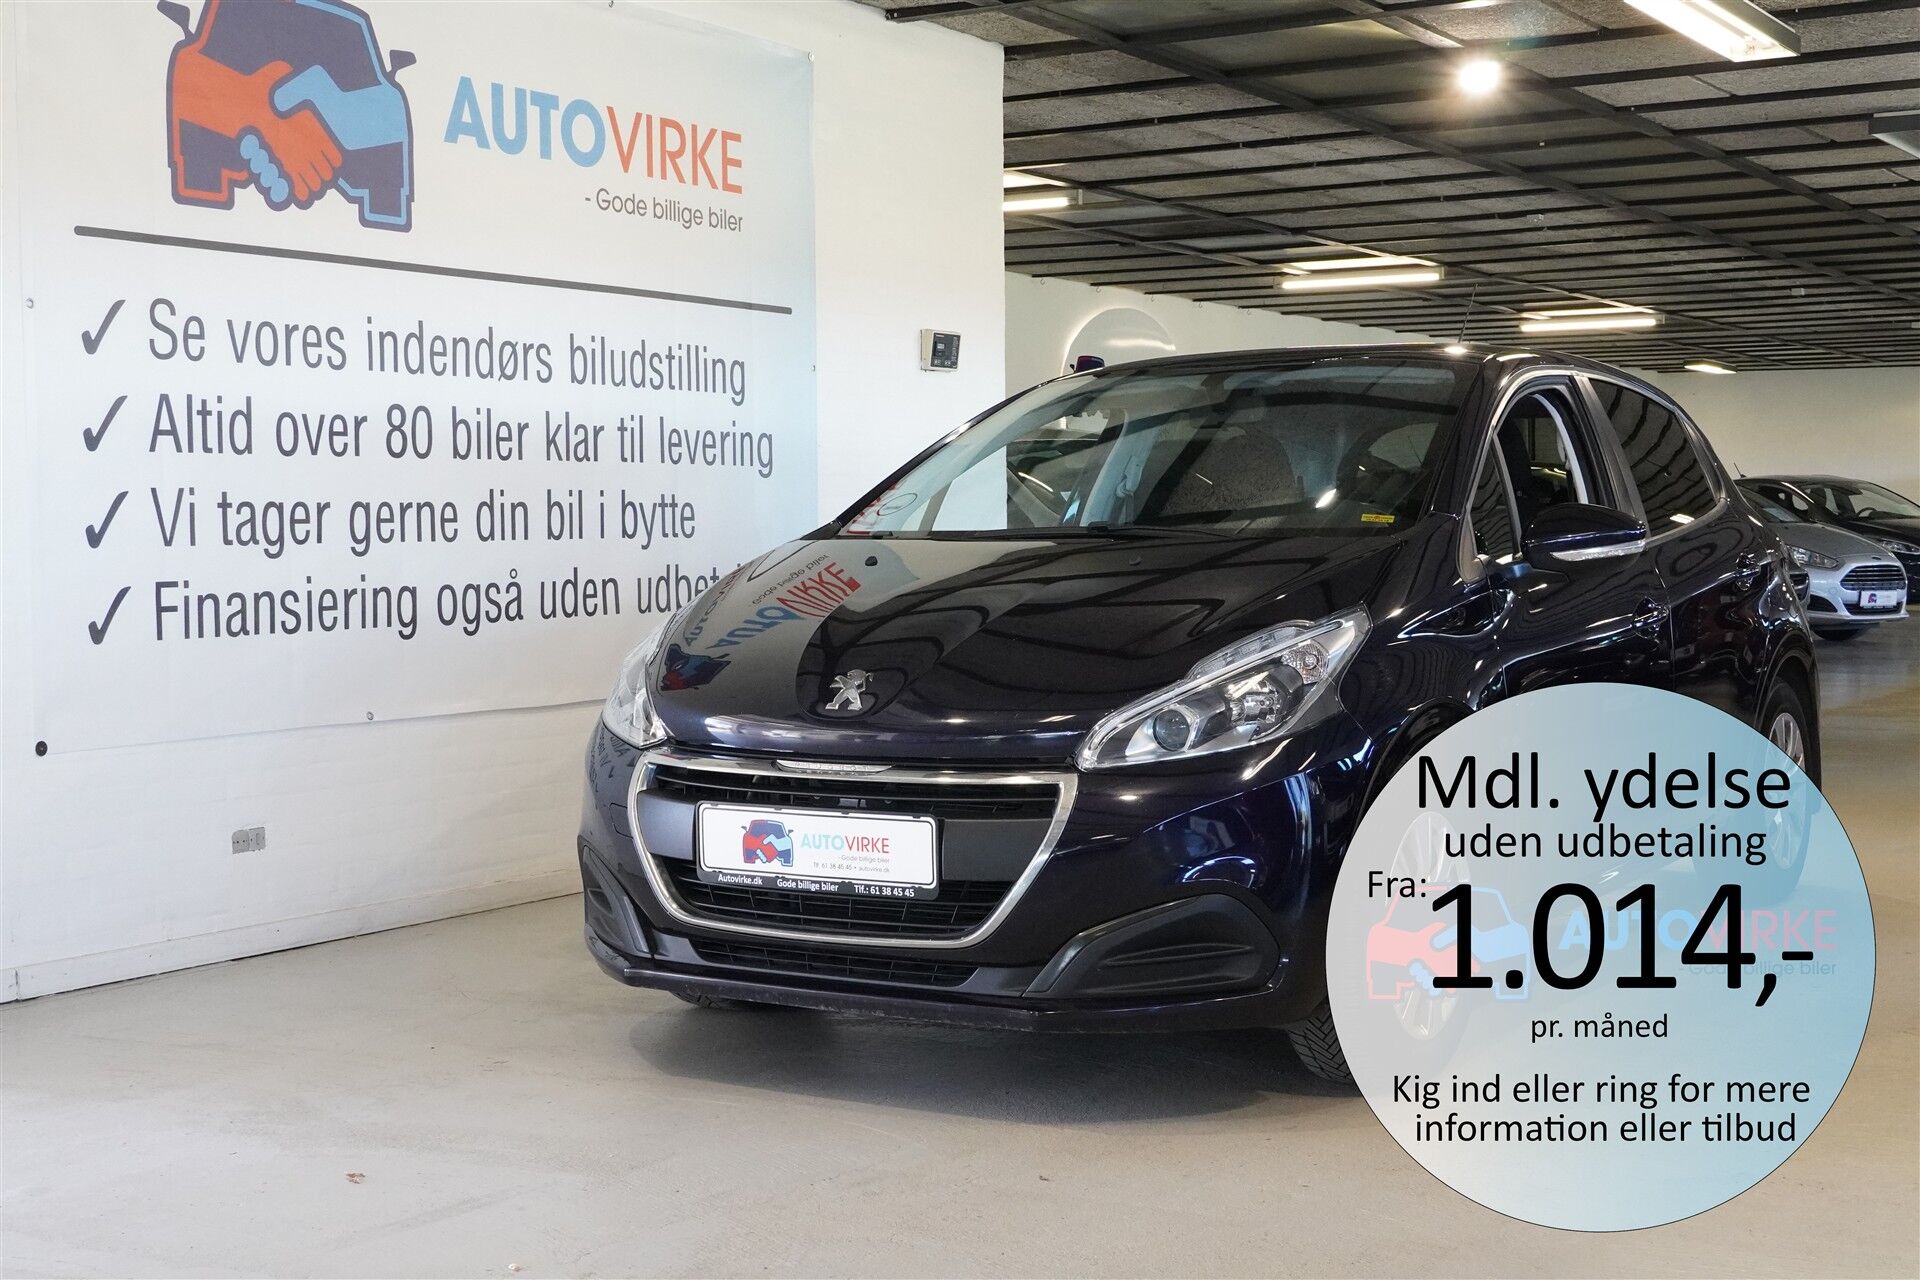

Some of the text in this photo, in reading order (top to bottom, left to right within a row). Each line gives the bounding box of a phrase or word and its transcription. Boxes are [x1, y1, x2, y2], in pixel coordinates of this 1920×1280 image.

[443, 75, 743, 195] AUTOVIRKE
[596, 187, 648, 217] Gode
[652, 196, 704, 230] billige
[708, 206, 743, 233] biler
[148, 297, 746, 407] Se vores indendørs biludstilling
[148, 392, 774, 479] Altid over 80 biler klar til levering
[150, 486, 696, 560] Vi tager gerne din bil i bytte
[155, 573, 418, 641] Finansiering
[436, 567, 525, 637] også
[540, 566, 621, 620] uden
[637, 563, 741, 613] udbet
[800, 833, 890, 854] AUTOVIRKE
[717, 873, 915, 898] Autovirke.dk Gode billige biler Tlf.: 61 38 45 45
